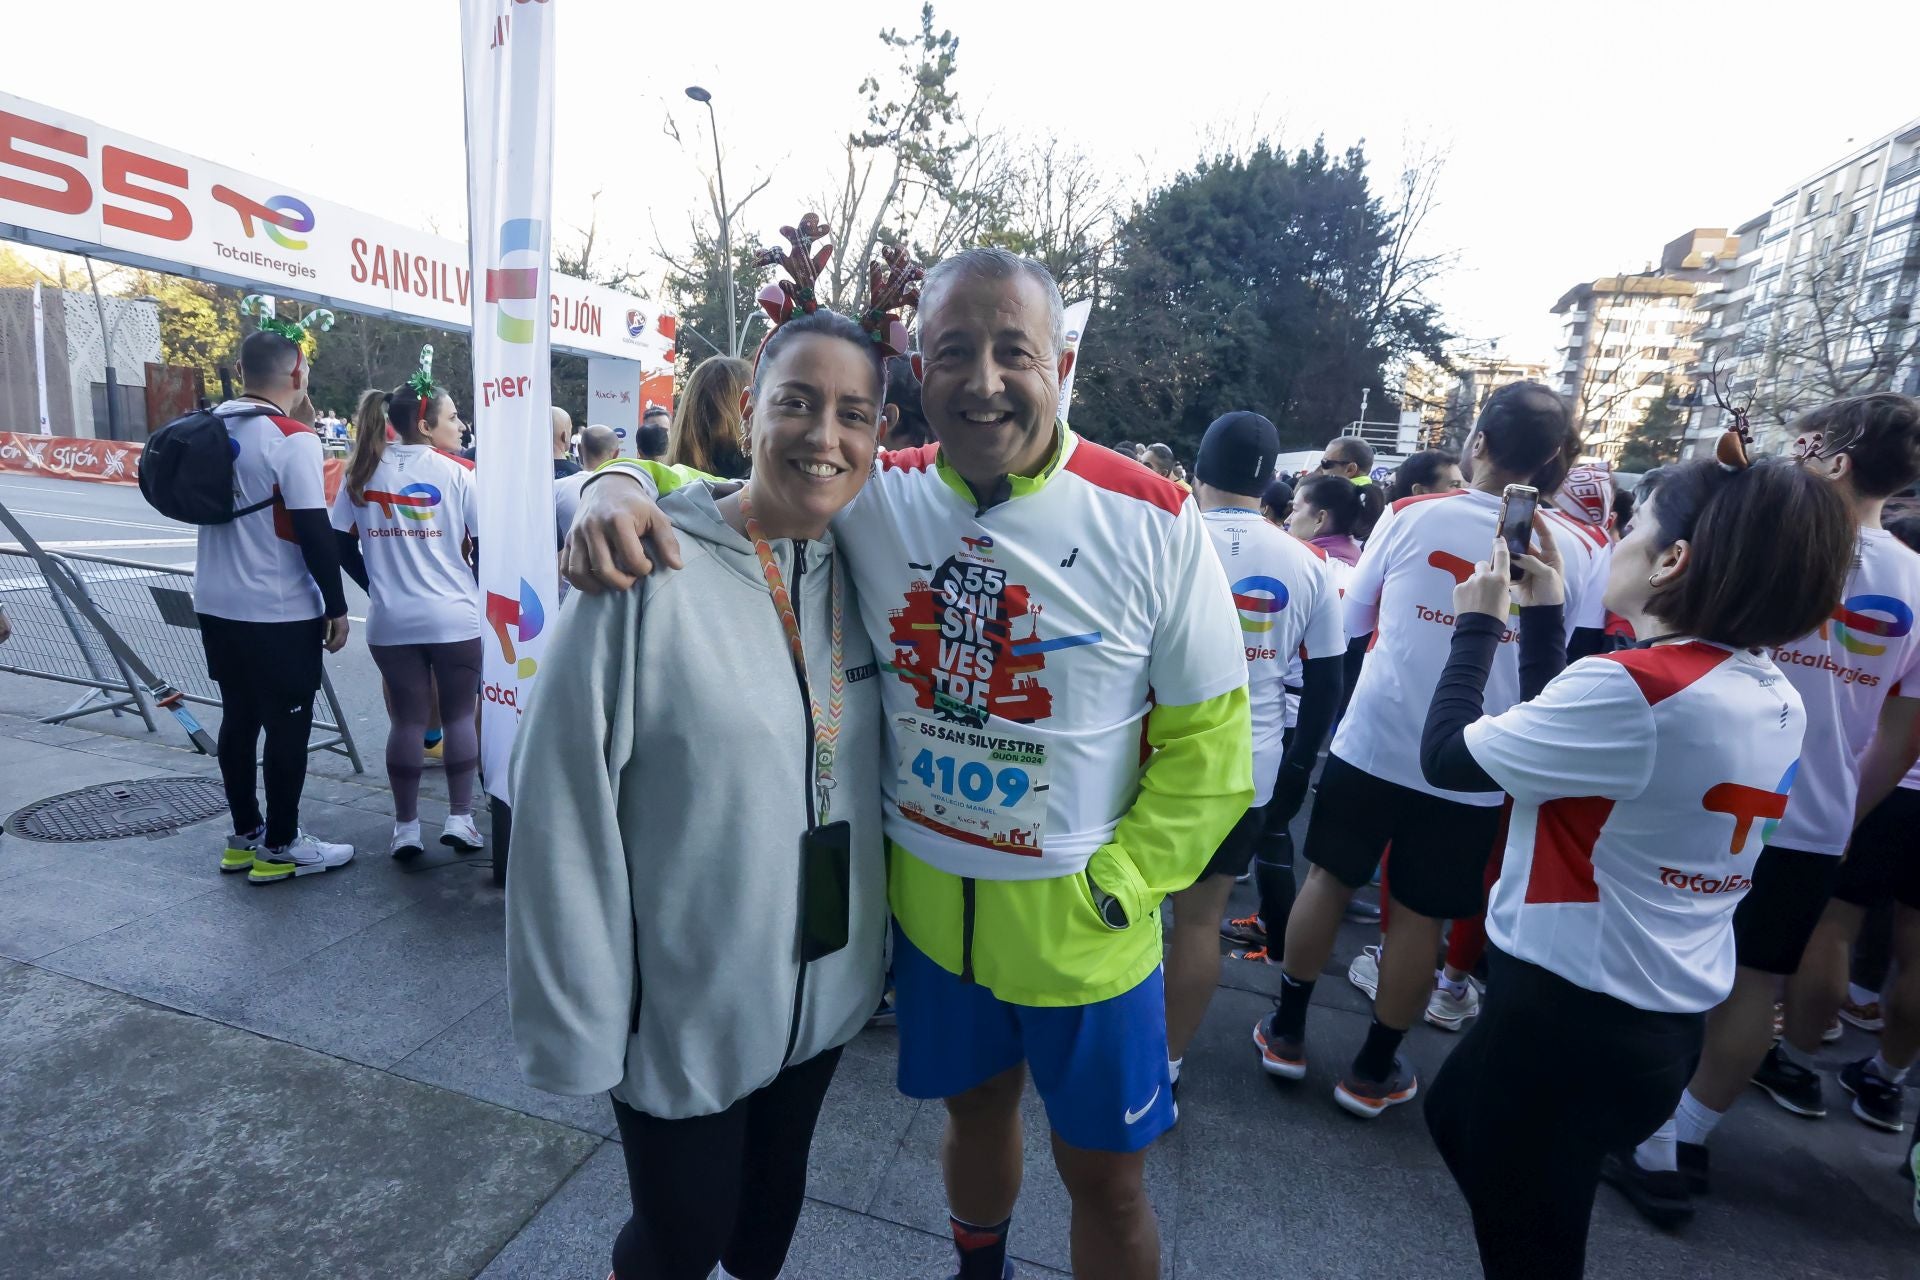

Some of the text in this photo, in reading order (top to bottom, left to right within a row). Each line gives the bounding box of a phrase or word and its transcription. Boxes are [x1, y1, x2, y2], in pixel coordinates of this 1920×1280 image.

[213, 241, 317, 279] TotalEnergies
[351, 238, 601, 337] SANSILV GIJÓN
[50, 446, 98, 471] gijón
[367, 527, 442, 540] TotalEnergies
[963, 566, 1004, 595] 55
[940, 579, 998, 620] SAN
[941, 606, 992, 647] SIL
[1415, 604, 1456, 627] Tota
[938, 639, 995, 681] VES
[1245, 644, 1277, 661] gies
[920, 722, 936, 737] 55
[937, 727, 966, 745] SAN
[968, 733, 1045, 756] SILVESTRE
[1020, 755, 1042, 765] 2024
[911, 748, 1030, 808] 4109
[965, 803, 997, 815] MANUEL
